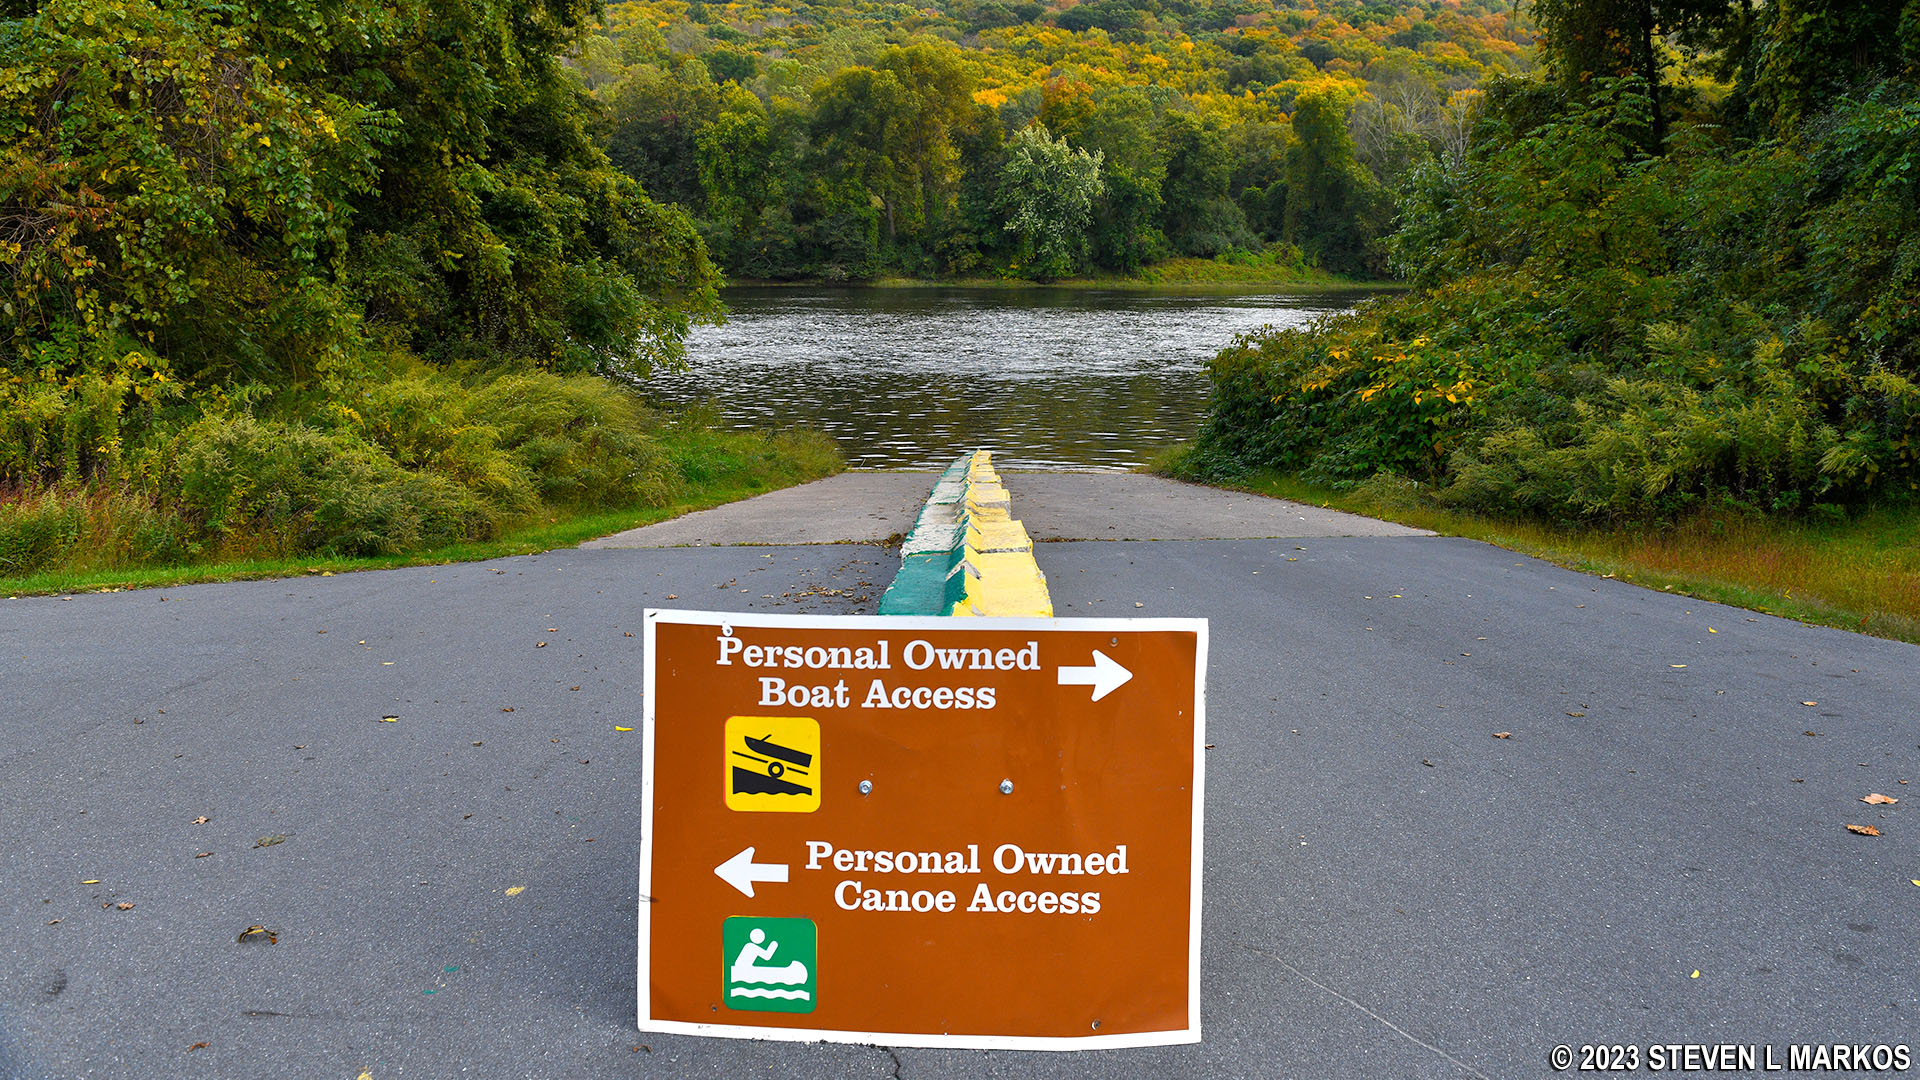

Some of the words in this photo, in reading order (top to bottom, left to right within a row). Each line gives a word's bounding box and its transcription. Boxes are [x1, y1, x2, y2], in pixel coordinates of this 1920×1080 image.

[716, 637, 891, 670] Personal
[903, 639, 1041, 671] Owned
[758, 677, 850, 708] Boat
[861, 679, 997, 710] Access
[805, 840, 981, 874] Personal
[993, 843, 1130, 876] Owned
[834, 880, 957, 913] Canoe
[966, 883, 1101, 915] Access
